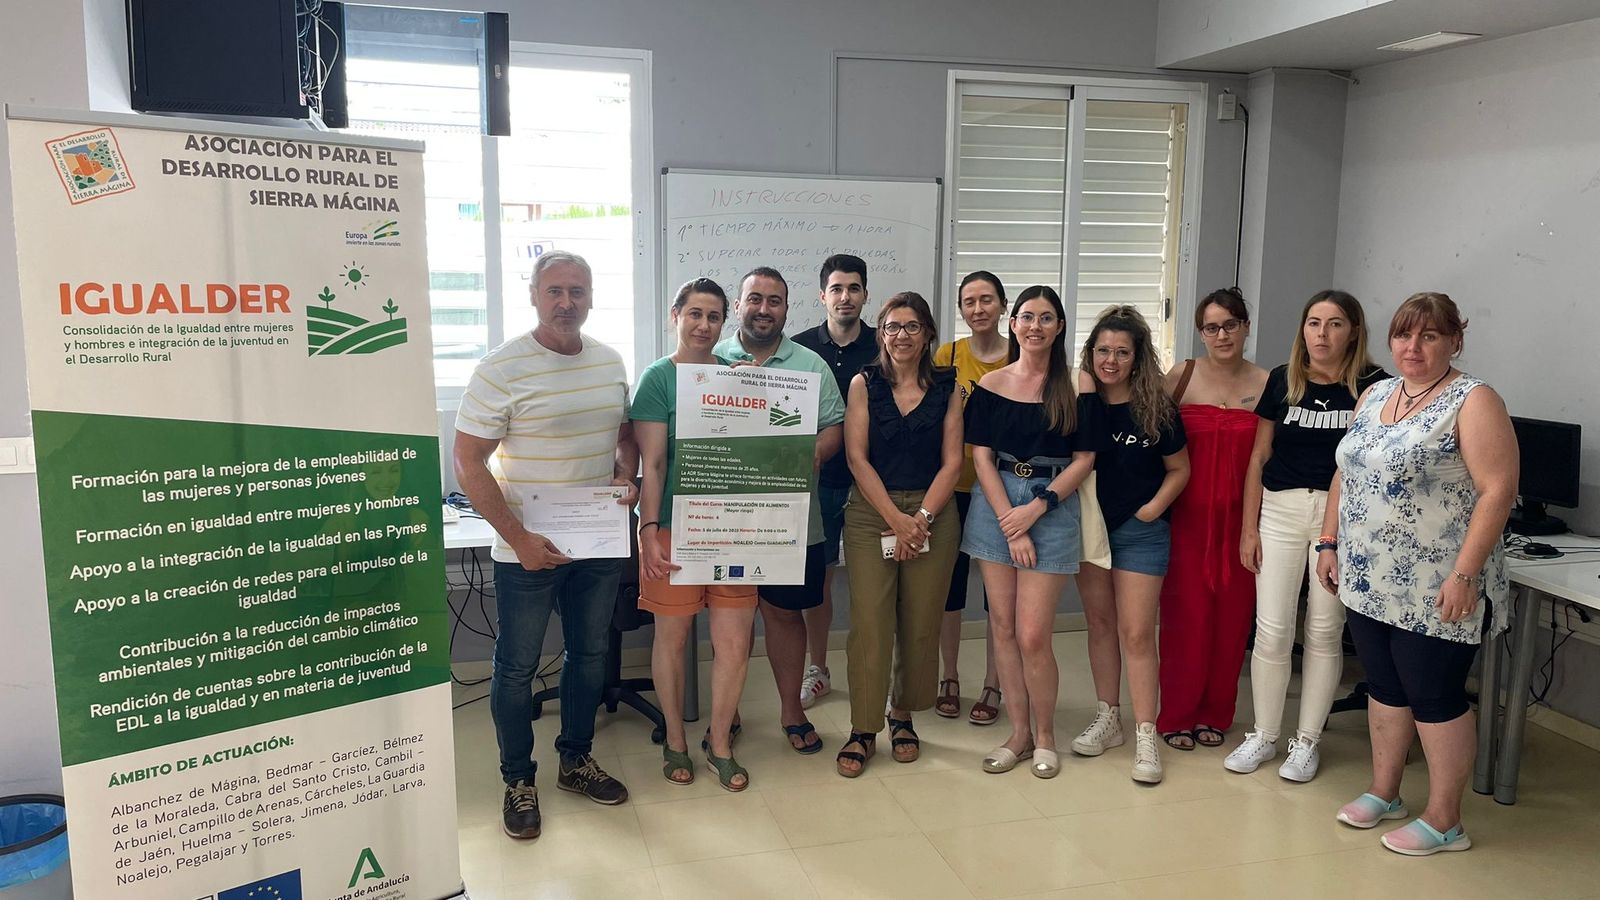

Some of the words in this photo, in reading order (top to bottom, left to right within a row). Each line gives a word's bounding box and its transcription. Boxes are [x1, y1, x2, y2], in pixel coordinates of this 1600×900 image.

[185, 134, 312, 159] ASOCIACIÓN
[318, 145, 371, 164] PARA
[376, 150, 398, 166] EL
[161, 158, 300, 182] DESARROLLO
[305, 169, 369, 187] RURAL
[374, 174, 398, 189] DE
[249, 189, 318, 207] SIERRA
[322, 191, 399, 212] MÁGINA
[712, 188, 872, 208] INSTRUCCIONES
[346, 231, 368, 240] Europa
[700, 223, 756, 236] TIEMPO
[59, 282, 290, 314] IGUALDER
[62, 324, 143, 335] Consolidación
[147, 324, 160, 333] de
[163, 324, 173, 333] la
[176, 323, 220, 335] Igualdad
[224, 324, 250, 332] entre
[253, 322, 293, 334] mujeres
[74, 339, 125, 349] hombres
[138, 337, 199, 349] integración
[202, 337, 215, 346] de
[218, 336, 227, 346] la
[230, 336, 273, 348] juventud
[79, 352, 139, 363] Desarrollo
[142, 351, 171, 361] Rural
[716, 370, 750, 378] ASOCIACIÓN
[775, 376, 808, 384] DESARROLLO
[786, 383, 807, 391] MÁGINA
[702, 394, 767, 409] IGUALDER
[71, 469, 158, 489] Formación
[163, 468, 197, 484] para
[202, 464, 214, 477] la
[219, 461, 269, 477] mejora
[273, 458, 290, 470] de
[294, 456, 306, 468] la
[310, 448, 398, 469] empleabilidad
[402, 447, 416, 459] de
[142, 489, 164, 502] las
[169, 484, 230, 500] mujeres
[248, 477, 312, 495] personas
[315, 472, 365, 488] jóvenes
[76, 522, 162, 543] Formación
[167, 522, 185, 532] en
[190, 511, 251, 532] igualdad
[256, 509, 292, 522] entre
[297, 503, 350, 518] mujeres
[365, 495, 419, 510] hombres
[69, 563, 121, 581] Apoyo
[141, 556, 154, 569] la
[159, 545, 243, 567] integración
[247, 542, 264, 555] de
[268, 540, 280, 552] la
[285, 531, 340, 552] igualdad
[344, 532, 360, 542] en
[364, 527, 382, 539] las
[386, 523, 426, 538] Pymes
[74, 596, 125, 614] Apoyo
[144, 589, 158, 602] la
[163, 579, 228, 599] creación
[232, 576, 249, 588] de
[254, 570, 293, 586] redes
[297, 567, 326, 582] para
[331, 561, 342, 574] el
[346, 556, 395, 573] impulso
[399, 552, 413, 564] de
[417, 550, 427, 561] la
[238, 586, 296, 608] igualdad
[119, 631, 217, 658] Contribución
[235, 626, 247, 638] la
[252, 614, 319, 636] reducción
[324, 610, 339, 623] de
[343, 602, 401, 621] impactos
[98, 656, 192, 682] ambientales
[210, 638, 283, 662] mitigación
[287, 632, 308, 647] del
[312, 624, 358, 642] cambio
[362, 615, 418, 633] climático
[90, 692, 167, 717] Rendición
[172, 687, 190, 700] de
[195, 677, 252, 696] cuentas
[257, 668, 295, 684] sobre
[300, 663, 311, 675] la
[315, 647, 395, 672] contribución
[398, 643, 413, 655] de
[417, 640, 427, 652] la
[116, 714, 149, 732] EDL
[167, 708, 180, 721] la
[185, 693, 245, 719] igualdad
[262, 690, 279, 701] en
[283, 677, 334, 697] materia
[338, 673, 353, 685] de
[356, 659, 410, 685] juventud
[108, 763, 171, 787] ÁMBITO
[176, 757, 197, 771] DE
[202, 735, 293, 765] ACTUACIÓN:
[110, 793, 182, 818] Albanchez
[189, 787, 204, 798] de
[211, 775, 259, 793] Mágina,
[266, 760, 313, 779] Bedmar
[331, 745, 382, 764] Garcíez,
[383, 733, 423, 754] Bélmez
[112, 823, 128, 835] de
[135, 818, 147, 829] la
[154, 801, 218, 824] Moraleda,
[225, 790, 261, 805] Cabra
[268, 781, 286, 795] del
[292, 774, 326, 788] Santo
[332, 763, 369, 778] Cristo,
[375, 749, 412, 767] Cambil
[113, 827, 175, 852] Arbuniel,
[178, 812, 235, 834] Campillo
[238, 808, 252, 819] de
[255, 796, 302, 814] Arenas,
[304, 780, 365, 801] Cárcheles,
[368, 775, 380, 784] La
[382, 762, 424, 780] Guardia
[115, 857, 131, 868] de
[138, 847, 174, 862] Jaén,
[182, 831, 231, 851] Huelma
[252, 814, 294, 831] Solera,
[300, 800, 346, 818] Jimena,
[352, 789, 387, 804] Jódar,
[392, 778, 425, 793] Larva,
[116, 864, 171, 885] Noalejo,
[176, 845, 236, 869] Pegalajar
[251, 830, 294, 847] Torres.
[367, 874, 410, 894] Andalucía
